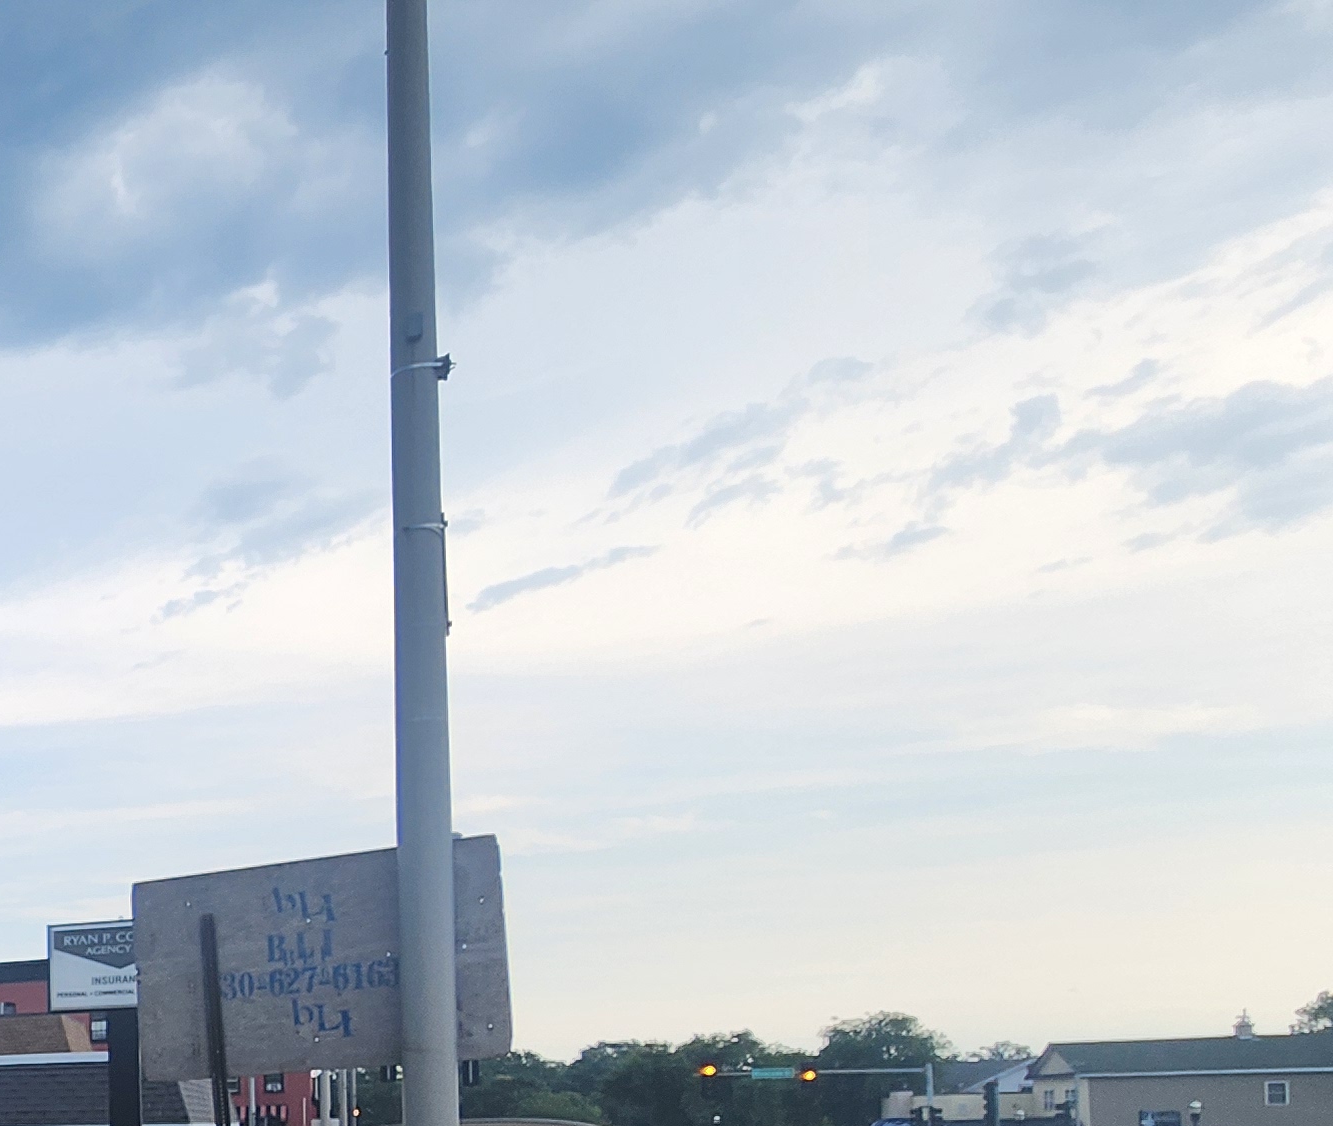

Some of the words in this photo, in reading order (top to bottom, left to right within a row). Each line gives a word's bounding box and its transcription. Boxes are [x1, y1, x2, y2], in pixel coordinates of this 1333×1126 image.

[63, 935, 99, 946] RYAN
[85, 944, 132, 956] AGENCY
[91, 975, 136, 986] INSURAN
